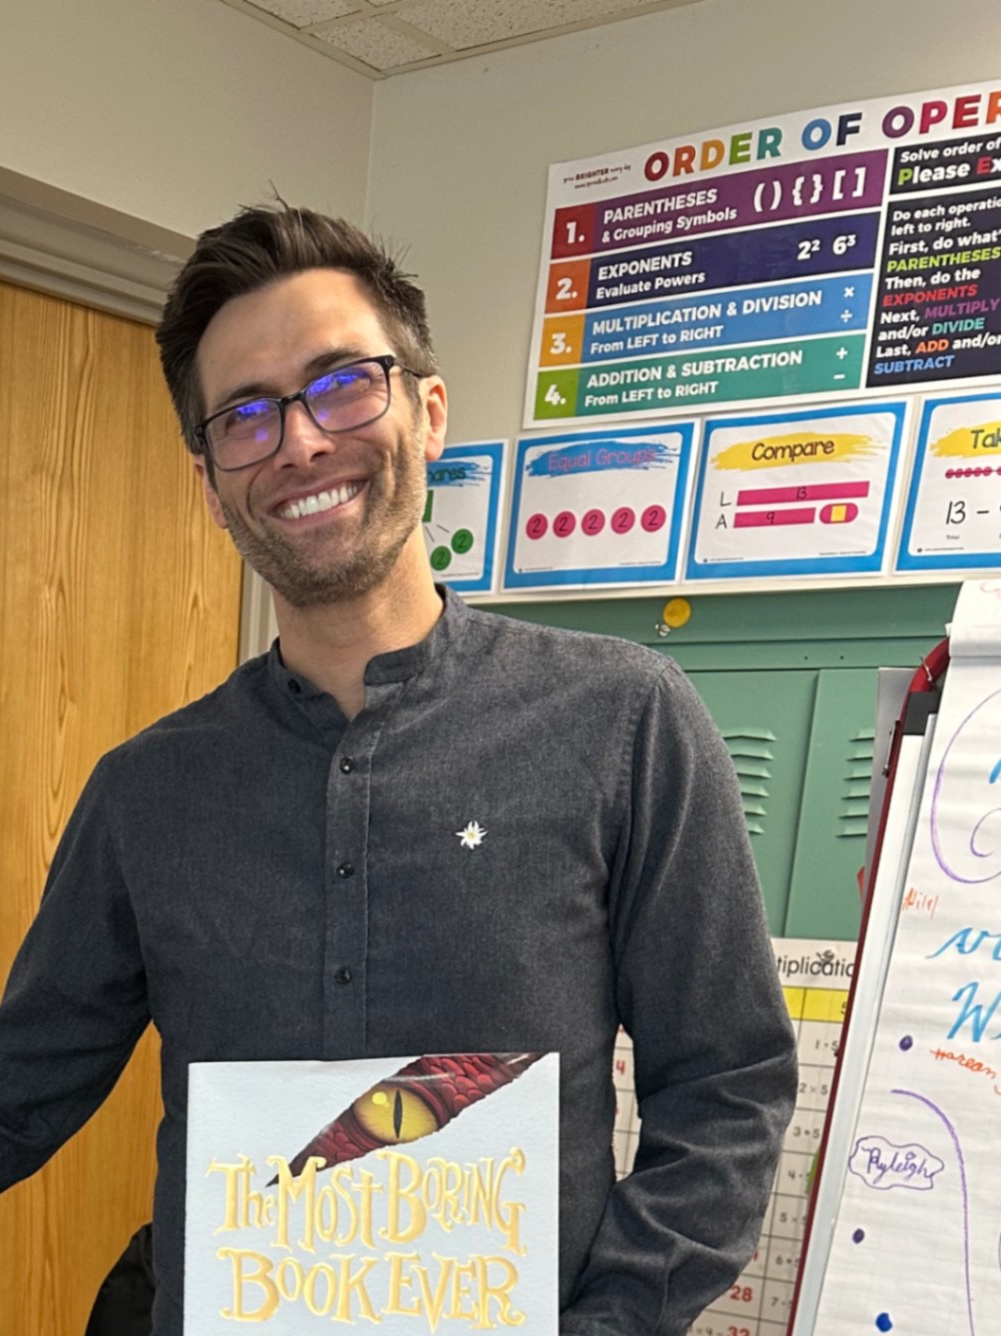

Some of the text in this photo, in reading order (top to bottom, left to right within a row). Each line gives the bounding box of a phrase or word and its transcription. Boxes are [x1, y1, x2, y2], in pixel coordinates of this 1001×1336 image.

[644, 127, 783, 182] ORDER
[801, 112, 863, 150] OF
[900, 149, 939, 163] Solve
[943, 141, 983, 157] order
[898, 163, 971, 185] Please
[566, 188, 718, 244] 1. PARENTHESES
[601, 207, 737, 243] & Grouping Symbols
[893, 210, 911, 221] Do
[914, 205, 945, 219] each
[891, 217, 971, 236] left to right.
[888, 240, 929, 255] First,
[933, 236, 954, 250] do
[886, 246, 1001, 273] PARENTHESES
[555, 277, 578, 300] 2.
[598, 251, 693, 281] EXPONENTS
[596, 272, 706, 300] Evaluate Powers
[885, 267, 981, 290] Then, do the
[882, 284, 978, 307] EXPONENTS
[550, 290, 823, 354] 3. MULTIPLICATION & DIVISION
[880, 298, 1001, 324] Next, MULTIPLY
[590, 325, 724, 355] From LEFT to RIGHT
[878, 317, 986, 341] and/or DIVIDE
[875, 343, 912, 358] Last,
[915, 338, 950, 354] ADD
[873, 354, 955, 375] SUBTRACT
[544, 350, 803, 406] 4. ADDITION & SUBTRACTION
[584, 381, 719, 407] From LEFT to RIGHT
[548, 446, 657, 471] Equal Groups
[751, 438, 835, 463] Compare
[720, 486, 808, 507] L 13
[532, 510, 658, 533] 2 2 2 2 2
[715, 513, 728, 529] A
[945, 500, 966, 525] 13
[383, 1251, 527, 1335] EVER
[730, 1284, 753, 1303] 28
